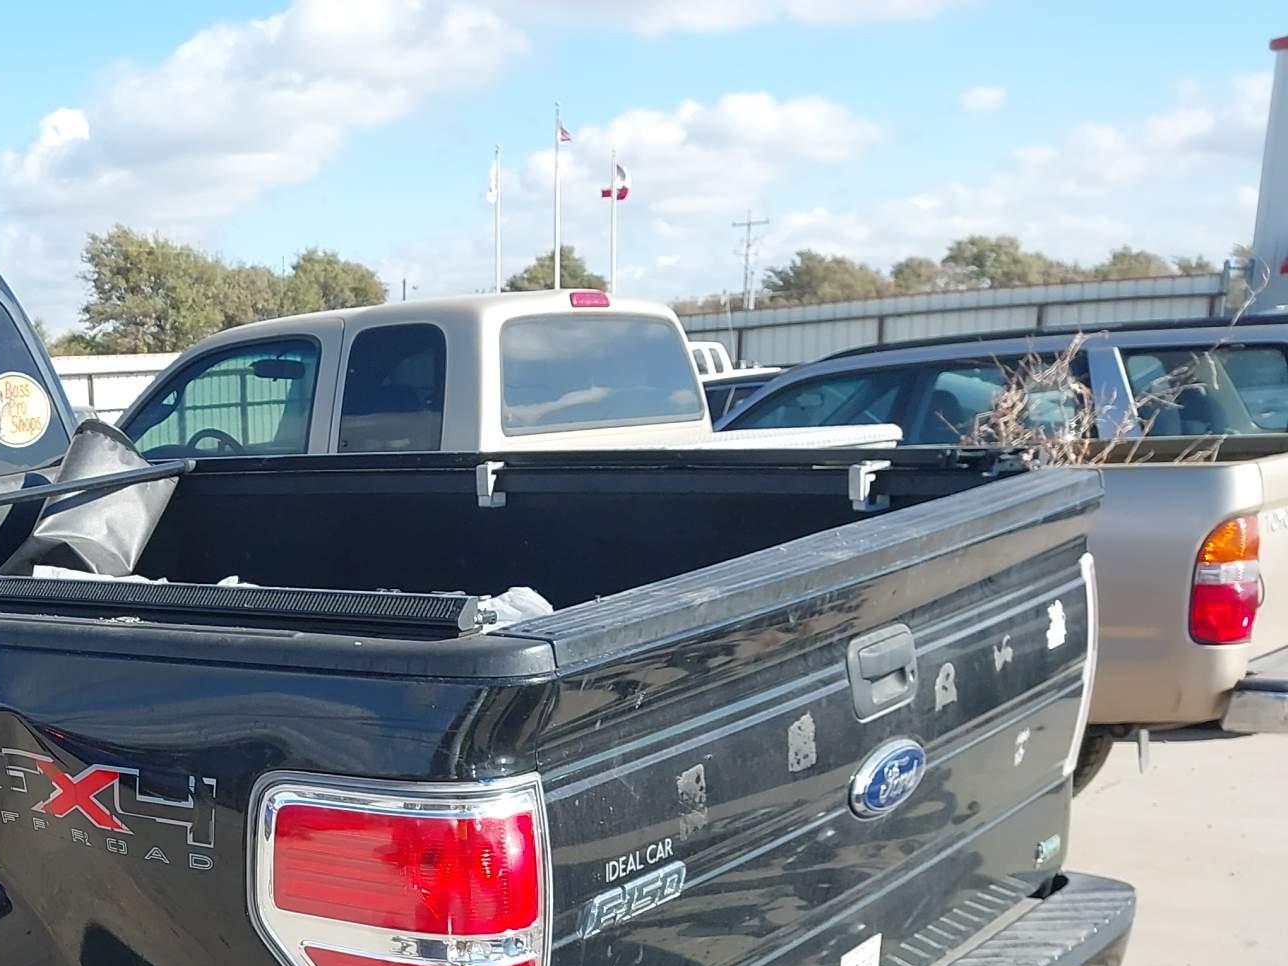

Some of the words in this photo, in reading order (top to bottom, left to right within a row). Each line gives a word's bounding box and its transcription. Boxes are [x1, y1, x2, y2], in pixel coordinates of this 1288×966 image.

[4, 380, 31, 400] Bass
[7, 399, 28, 417] Pro
[11, 416, 42, 436] Shops
[70, 827, 215, 871] ROAD
[605, 850, 645, 883] IDEAL
[646, 838, 674, 864] CAR
